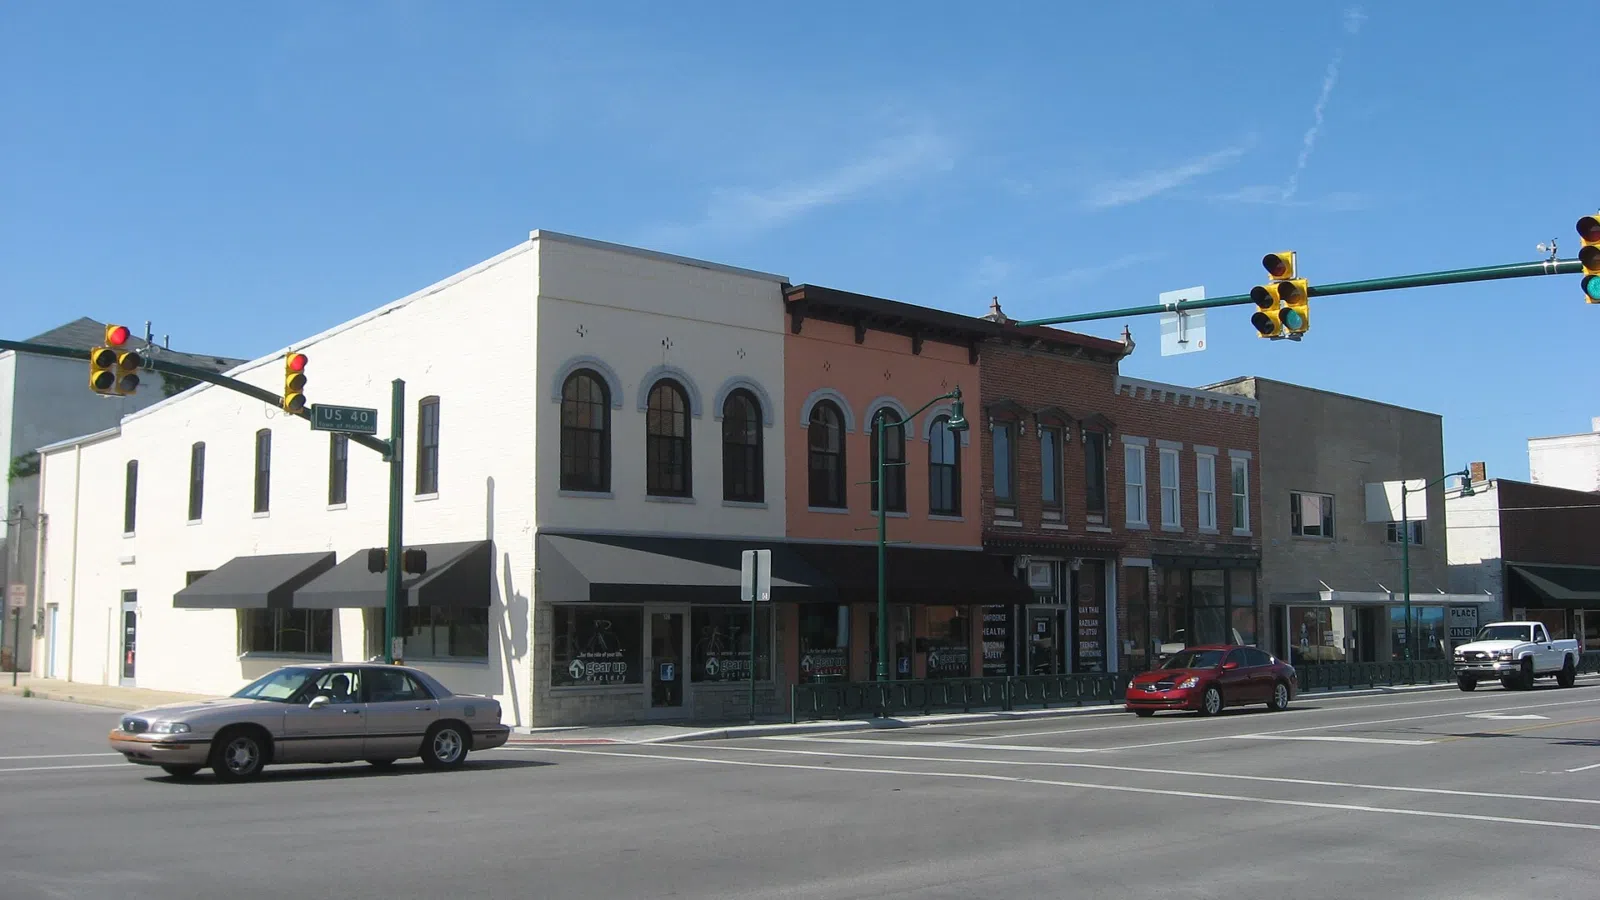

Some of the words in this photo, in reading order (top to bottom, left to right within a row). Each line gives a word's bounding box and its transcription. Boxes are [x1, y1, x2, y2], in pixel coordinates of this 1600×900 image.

[324, 408, 342, 421] US
[350, 411, 368, 423] 40
[1452, 609, 1475, 617] PLACE
[586, 661, 611, 676] gear
[612, 661, 627, 675] up
[720, 659, 742, 673] gear
[743, 660, 751, 670] u
[586, 674, 626, 682] cyclery
[721, 671, 751, 679] cycler
